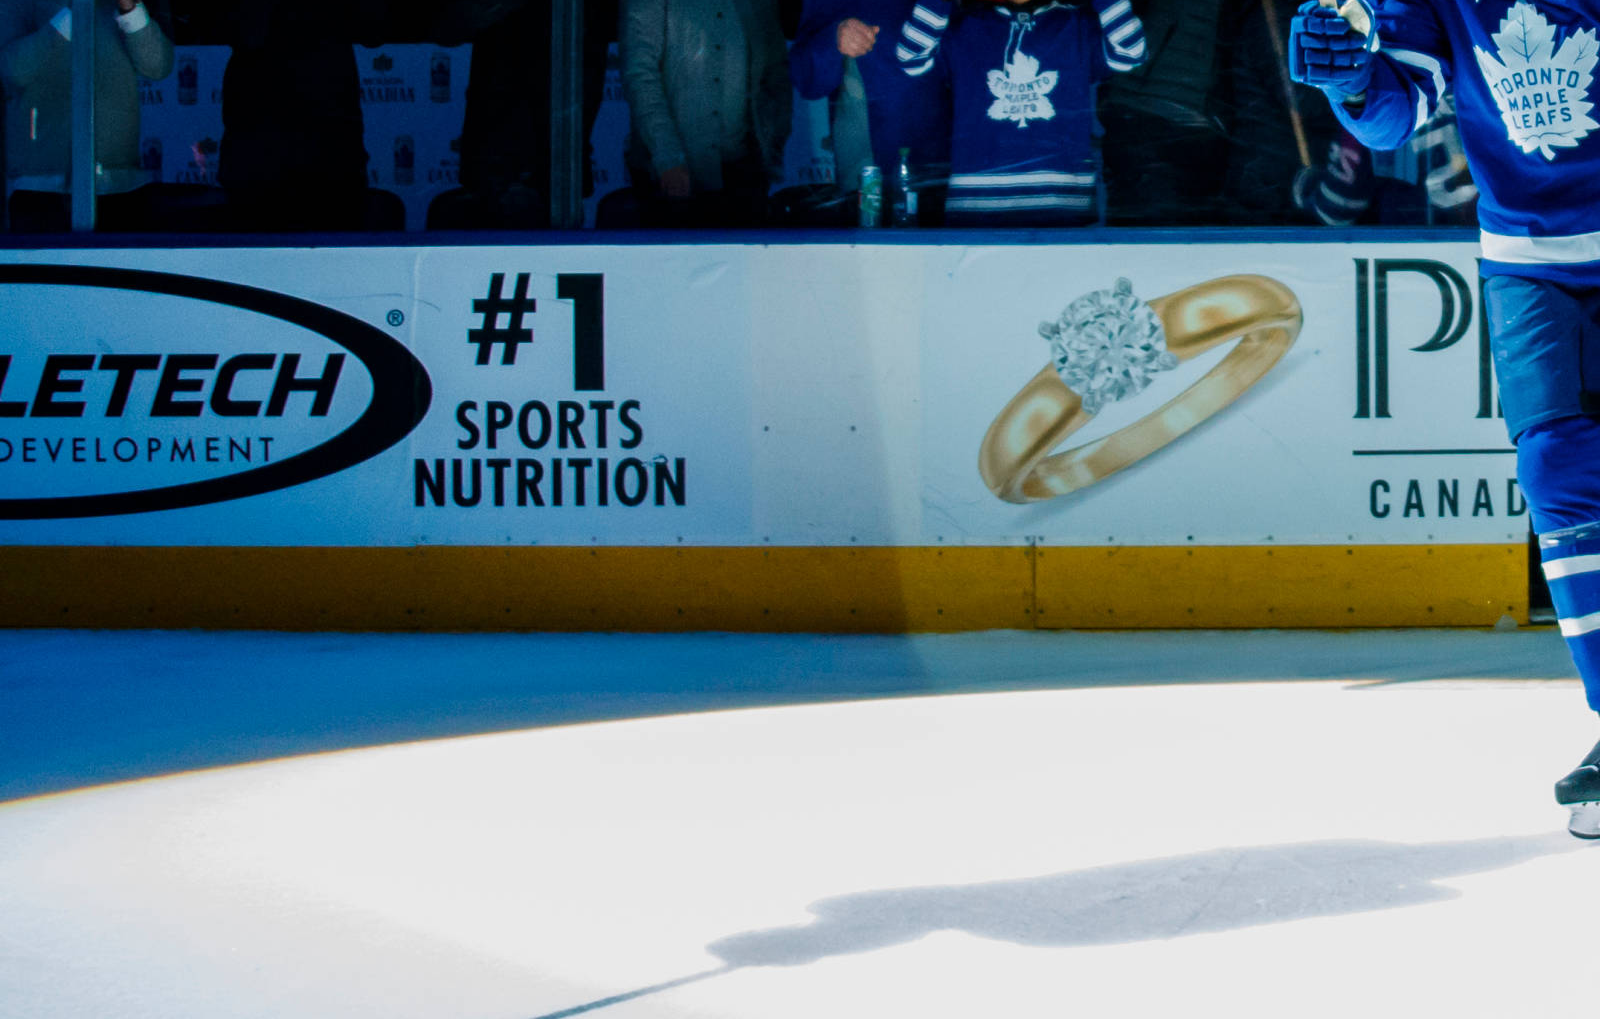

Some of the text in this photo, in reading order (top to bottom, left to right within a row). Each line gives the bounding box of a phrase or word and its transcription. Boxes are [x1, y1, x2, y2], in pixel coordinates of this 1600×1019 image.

[1493, 67, 1580, 100] TORONTO
[1508, 89, 1569, 112] MAPLE
[1512, 107, 1572, 130] LEAFS
[467, 272, 606, 392] #1
[456, 399, 644, 450] SPORTS
[414, 457, 687, 508] NUTRITION
